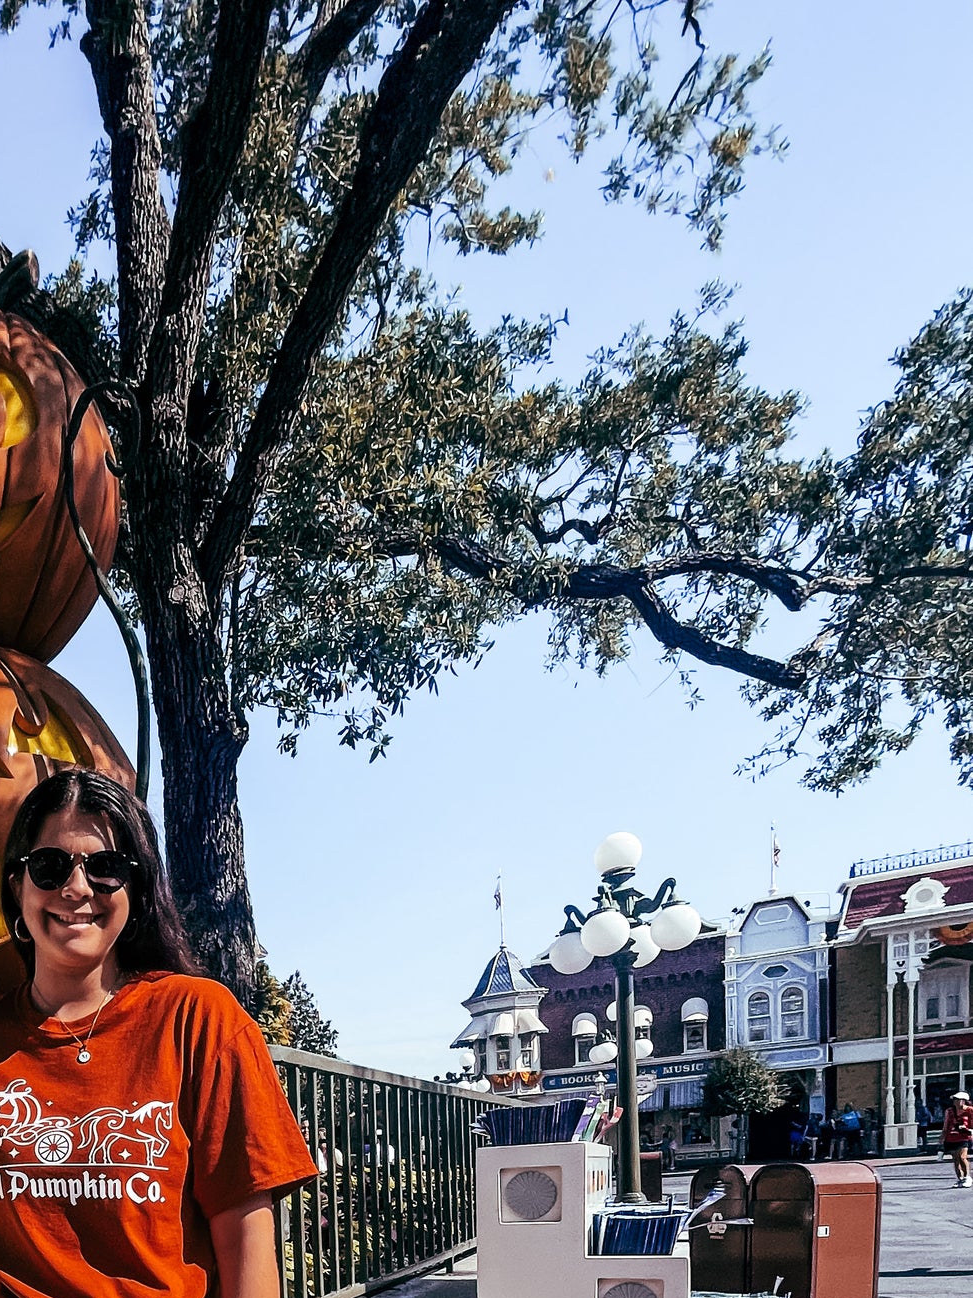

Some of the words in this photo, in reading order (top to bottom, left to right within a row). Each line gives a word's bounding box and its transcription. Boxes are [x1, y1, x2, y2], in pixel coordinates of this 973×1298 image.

[662, 1063, 704, 1075] MUSIC
[5, 1170, 122, 1206] Pumpkin
[126, 1172, 165, 1205] Co.
